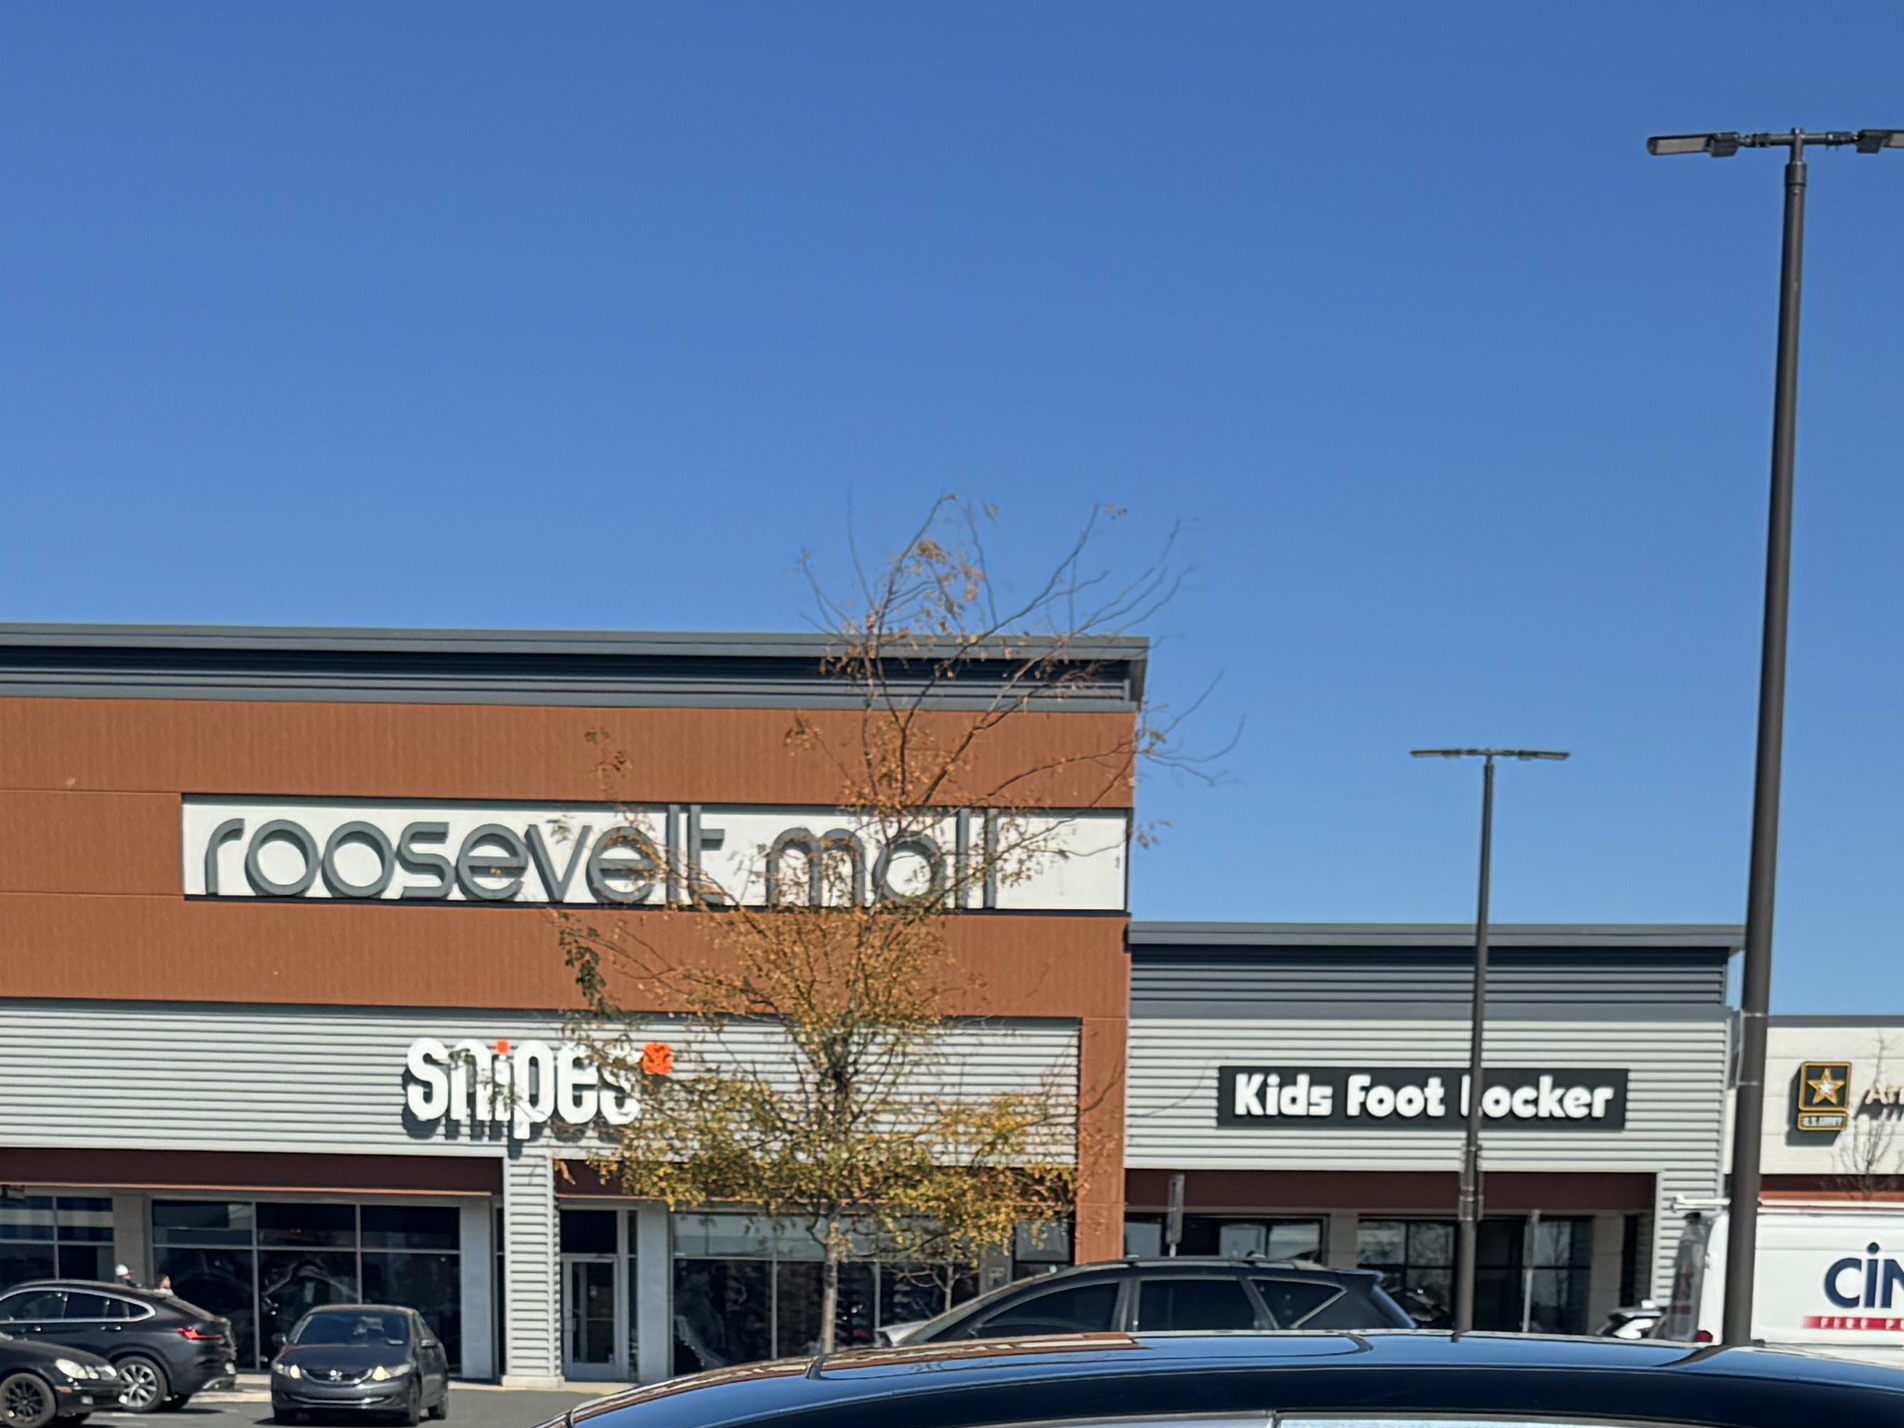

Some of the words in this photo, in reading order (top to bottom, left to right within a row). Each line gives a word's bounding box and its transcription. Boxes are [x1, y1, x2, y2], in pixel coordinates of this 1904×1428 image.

[206, 803, 725, 906] roosevelt
[766, 806, 998, 909] mall
[1233, 1073, 1334, 1117] Kids
[1346, 1074, 1446, 1118] Foot
